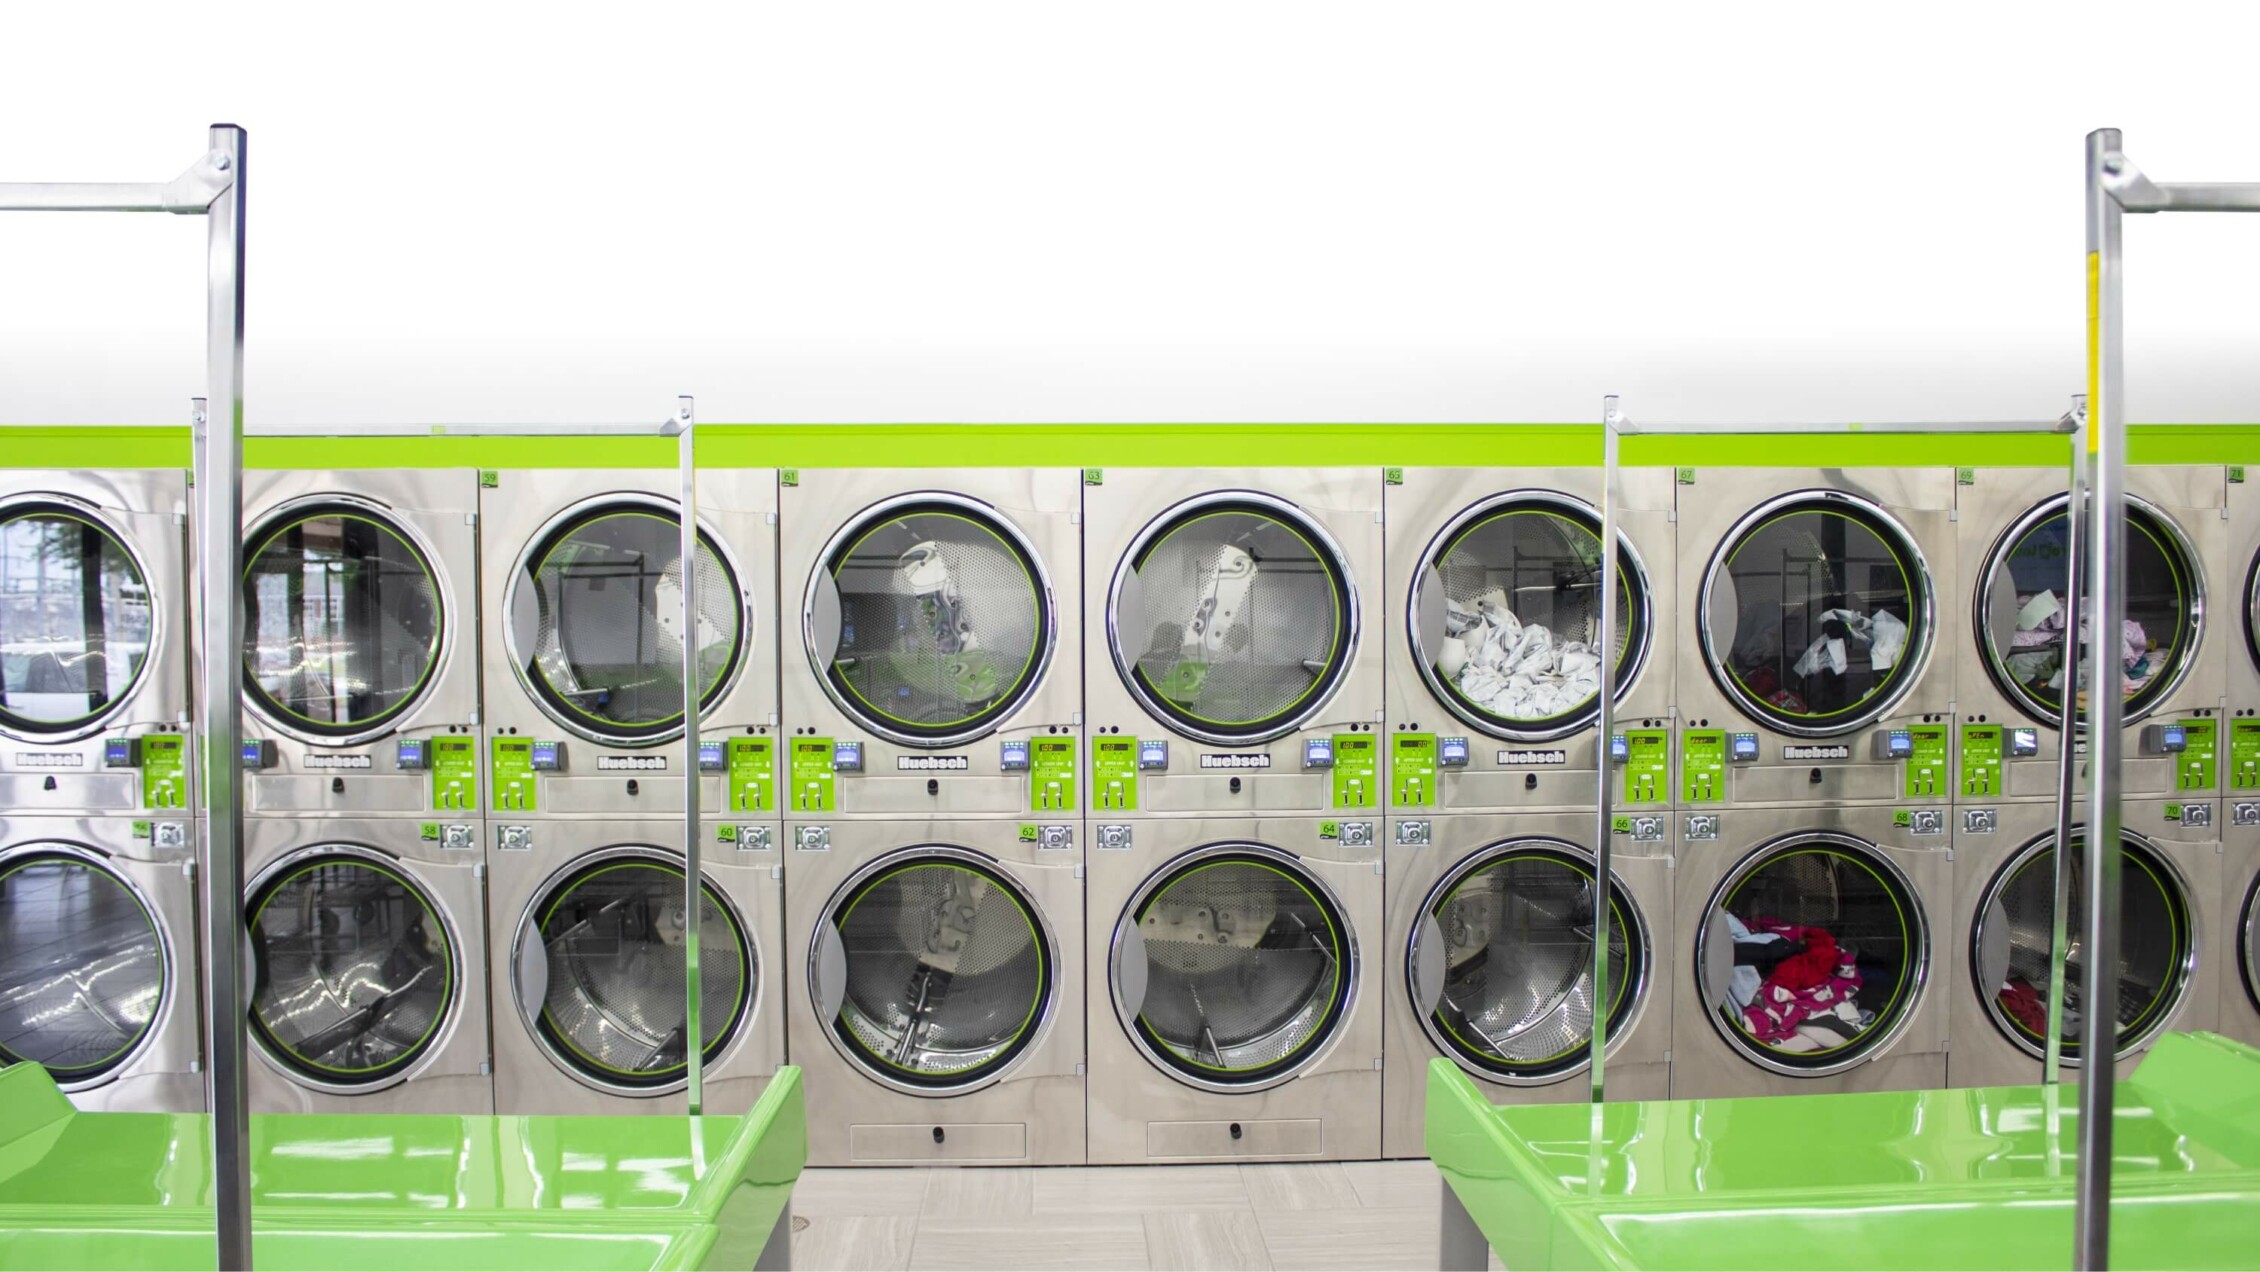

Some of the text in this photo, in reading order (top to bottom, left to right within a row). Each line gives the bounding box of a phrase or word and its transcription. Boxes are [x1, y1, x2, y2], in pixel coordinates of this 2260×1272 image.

[484, 473, 496, 482] 59
[784, 472, 796, 481] 61
[1389, 470, 1400, 479] 65
[1681, 471, 1692, 479] 67
[1961, 471, 1972, 480] 69
[1785, 746, 1848, 758] Huebsch
[17, 753, 82, 766] Huebsch
[305, 755, 371, 767] Huebsch
[1202, 754, 1270, 767] Huebsch
[1499, 751, 1565, 763] Huebsch
[598, 756, 666, 769] Huebsch
[899, 757, 967, 769] Huebsch
[2168, 806, 2178, 815] 70
[1896, 813, 1908, 821] 68
[1616, 819, 1628, 828] 66
[424, 826, 436, 834] 58
[720, 828, 733, 836] 60
[1022, 828, 1034, 836] 62
[1323, 825, 1335, 833] 64
